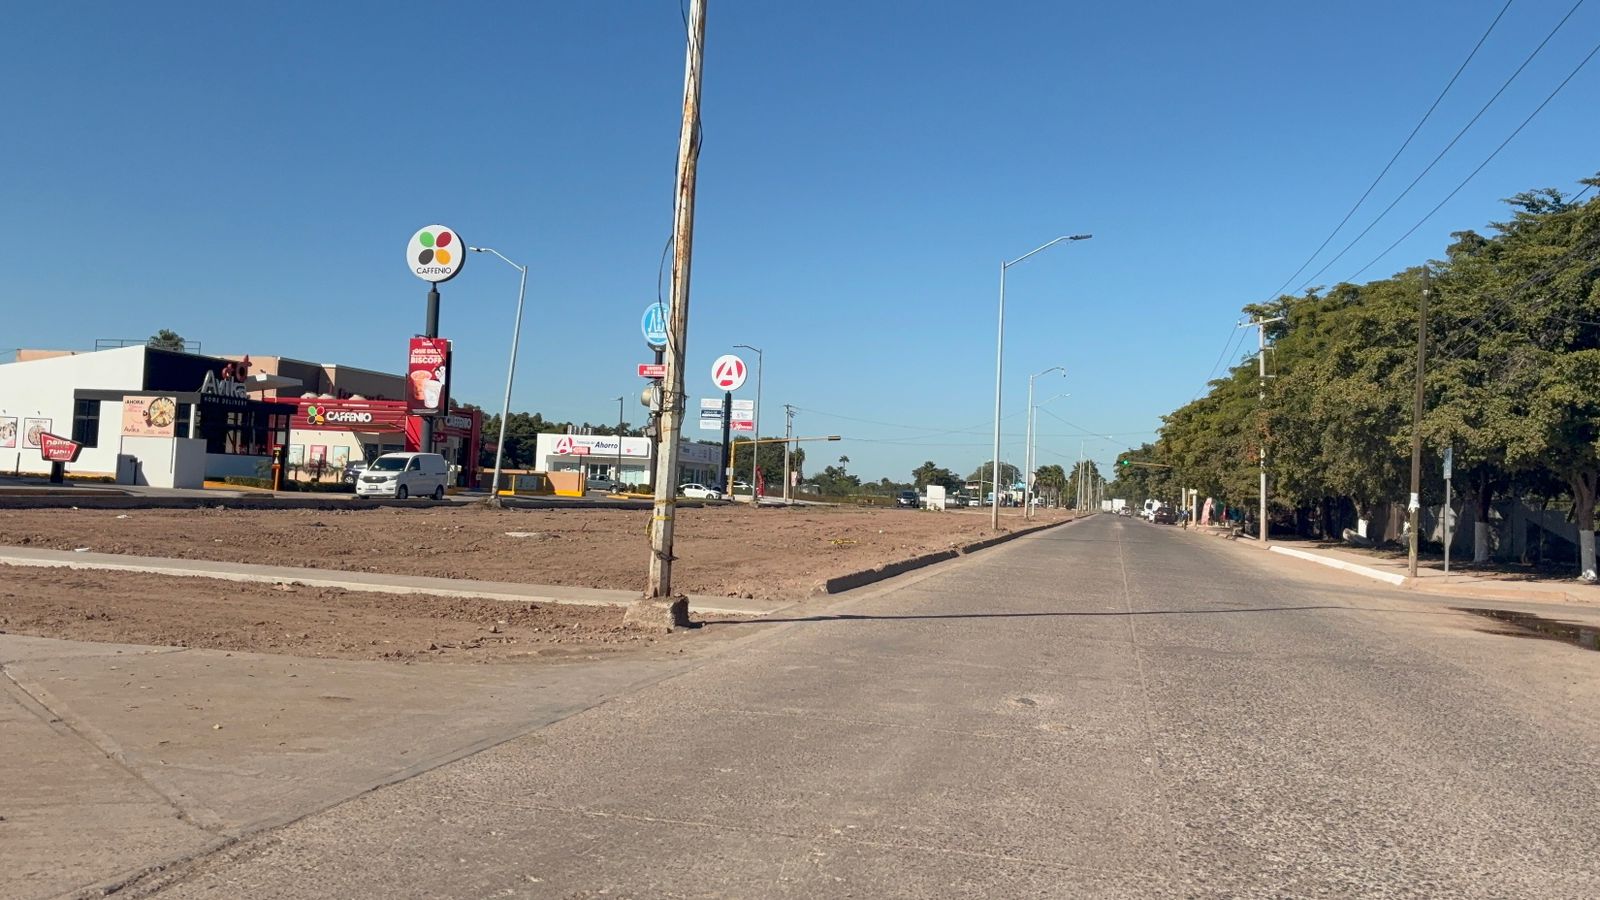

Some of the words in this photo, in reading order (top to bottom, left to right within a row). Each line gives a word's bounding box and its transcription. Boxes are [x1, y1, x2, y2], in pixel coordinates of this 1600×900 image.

[416, 267, 452, 275] CAFFENIO
[200, 369, 248, 399] Avika
[326, 411, 372, 422] CAFFENIO
[595, 441, 619, 449] Ahorro
